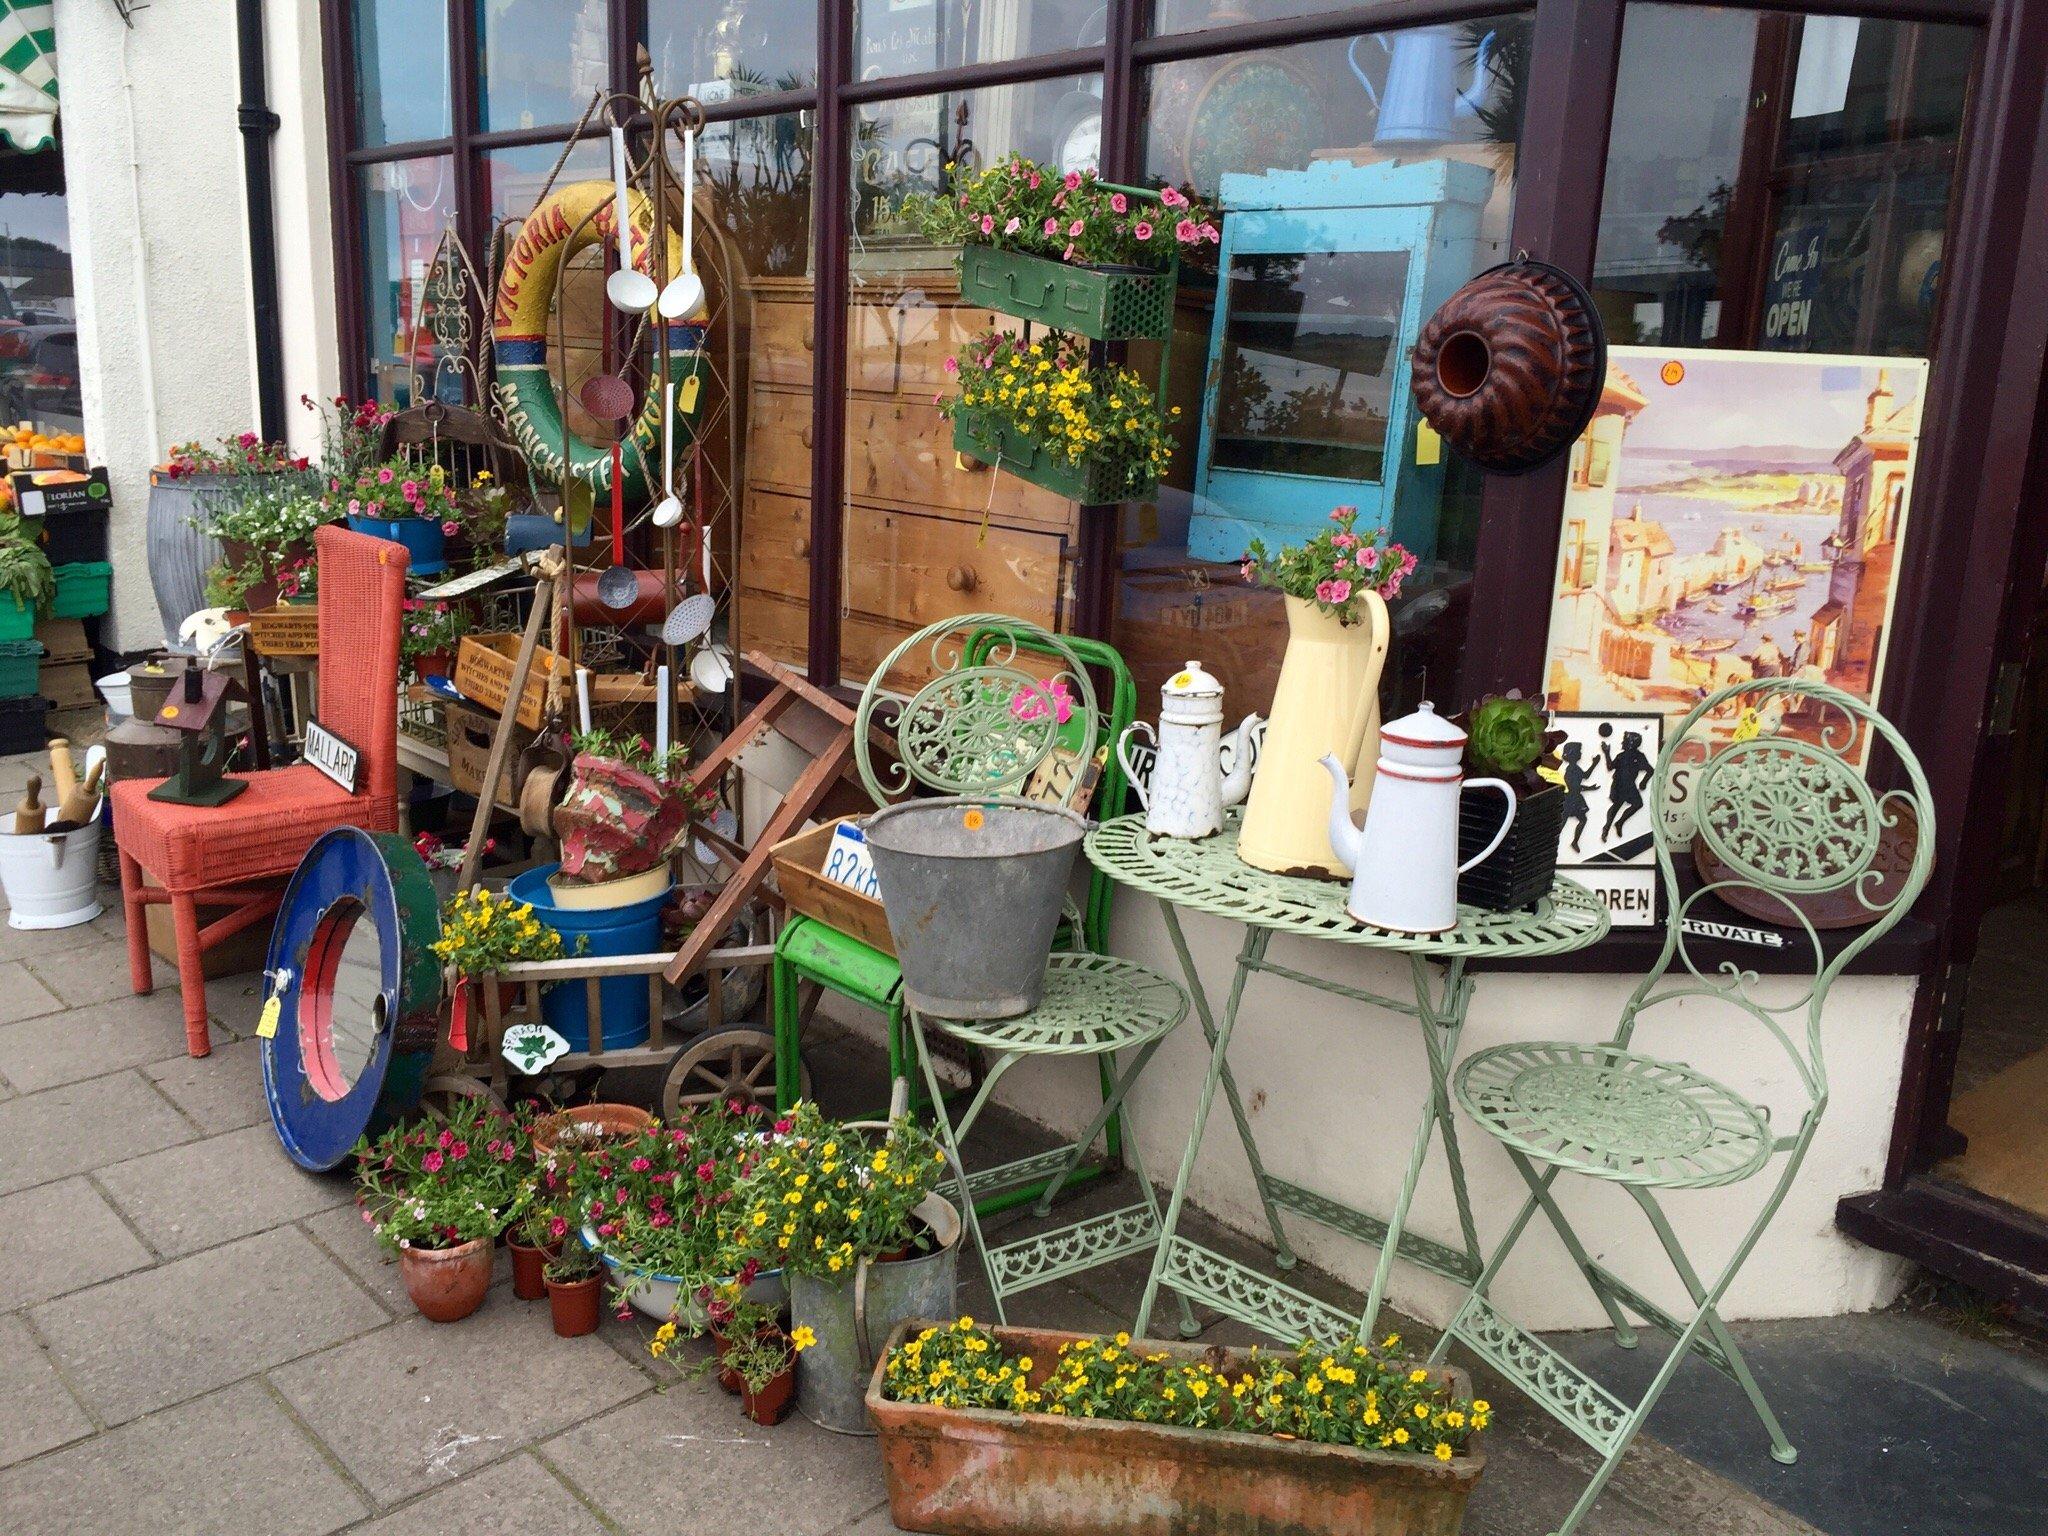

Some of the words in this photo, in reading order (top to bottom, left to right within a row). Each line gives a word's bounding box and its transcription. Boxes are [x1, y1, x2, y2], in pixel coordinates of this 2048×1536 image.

[495, 204, 573, 327] VICTORIA
[1775, 241, 1803, 281] Come
[1803, 236, 1819, 271] In
[1766, 299, 1811, 337] OPEN
[307, 728, 355, 783] MALLARD
[1596, 889, 1649, 911] DREN
[1682, 919, 1777, 945] RIVATE
